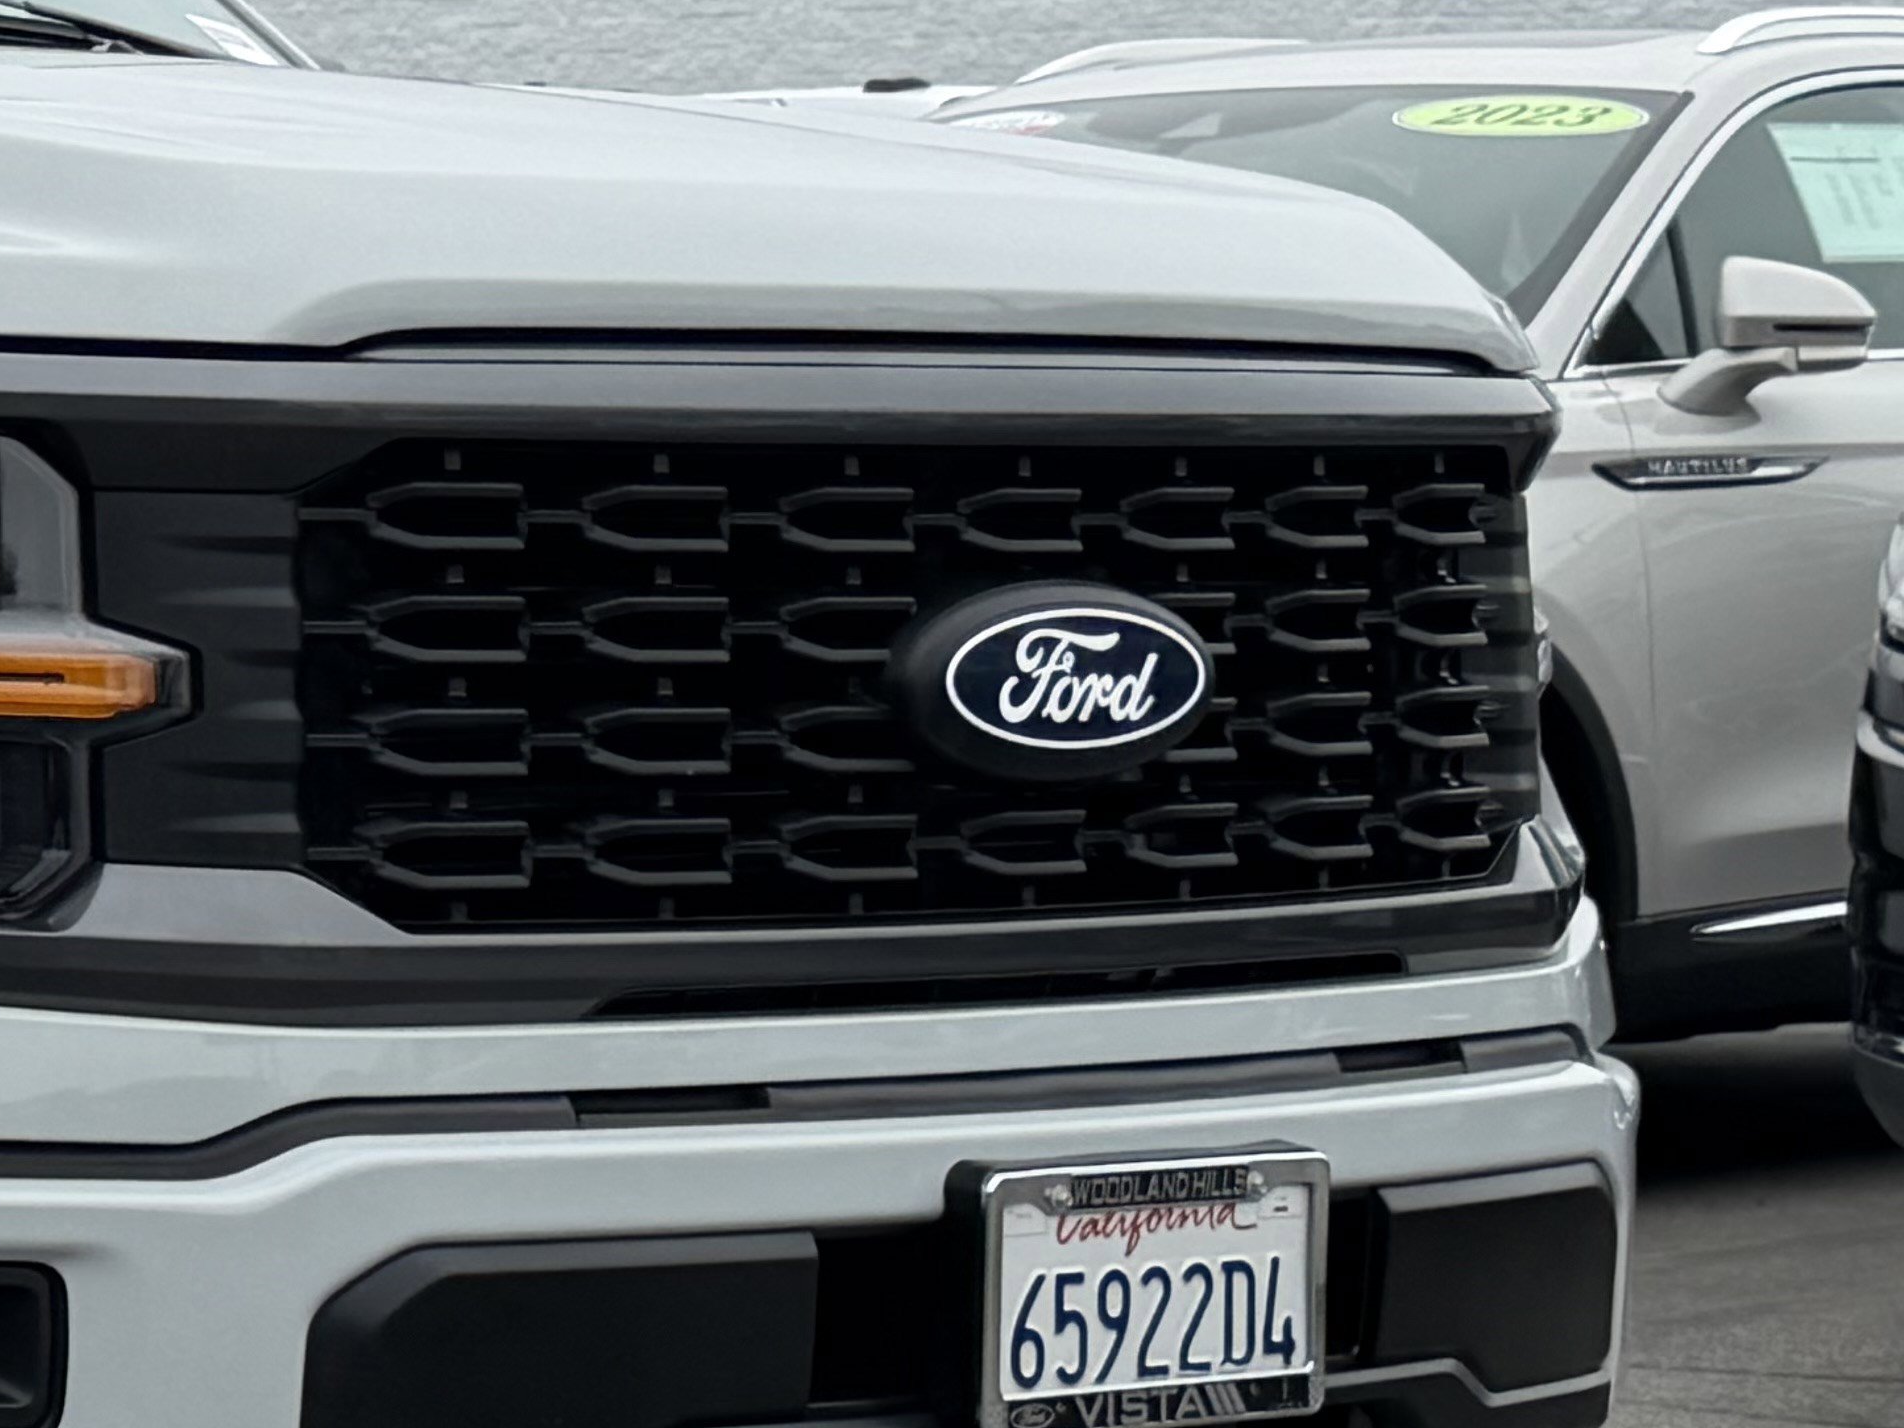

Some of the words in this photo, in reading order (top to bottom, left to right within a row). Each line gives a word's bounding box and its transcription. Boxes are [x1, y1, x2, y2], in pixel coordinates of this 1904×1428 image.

[1433, 104, 1613, 129] 2023
[998, 627, 1159, 724] Ford
[1072, 1174, 1189, 1206] WOODLAND
[1195, 1167, 1249, 1197] HILLS
[1010, 1255, 1296, 1389] 65922D4
